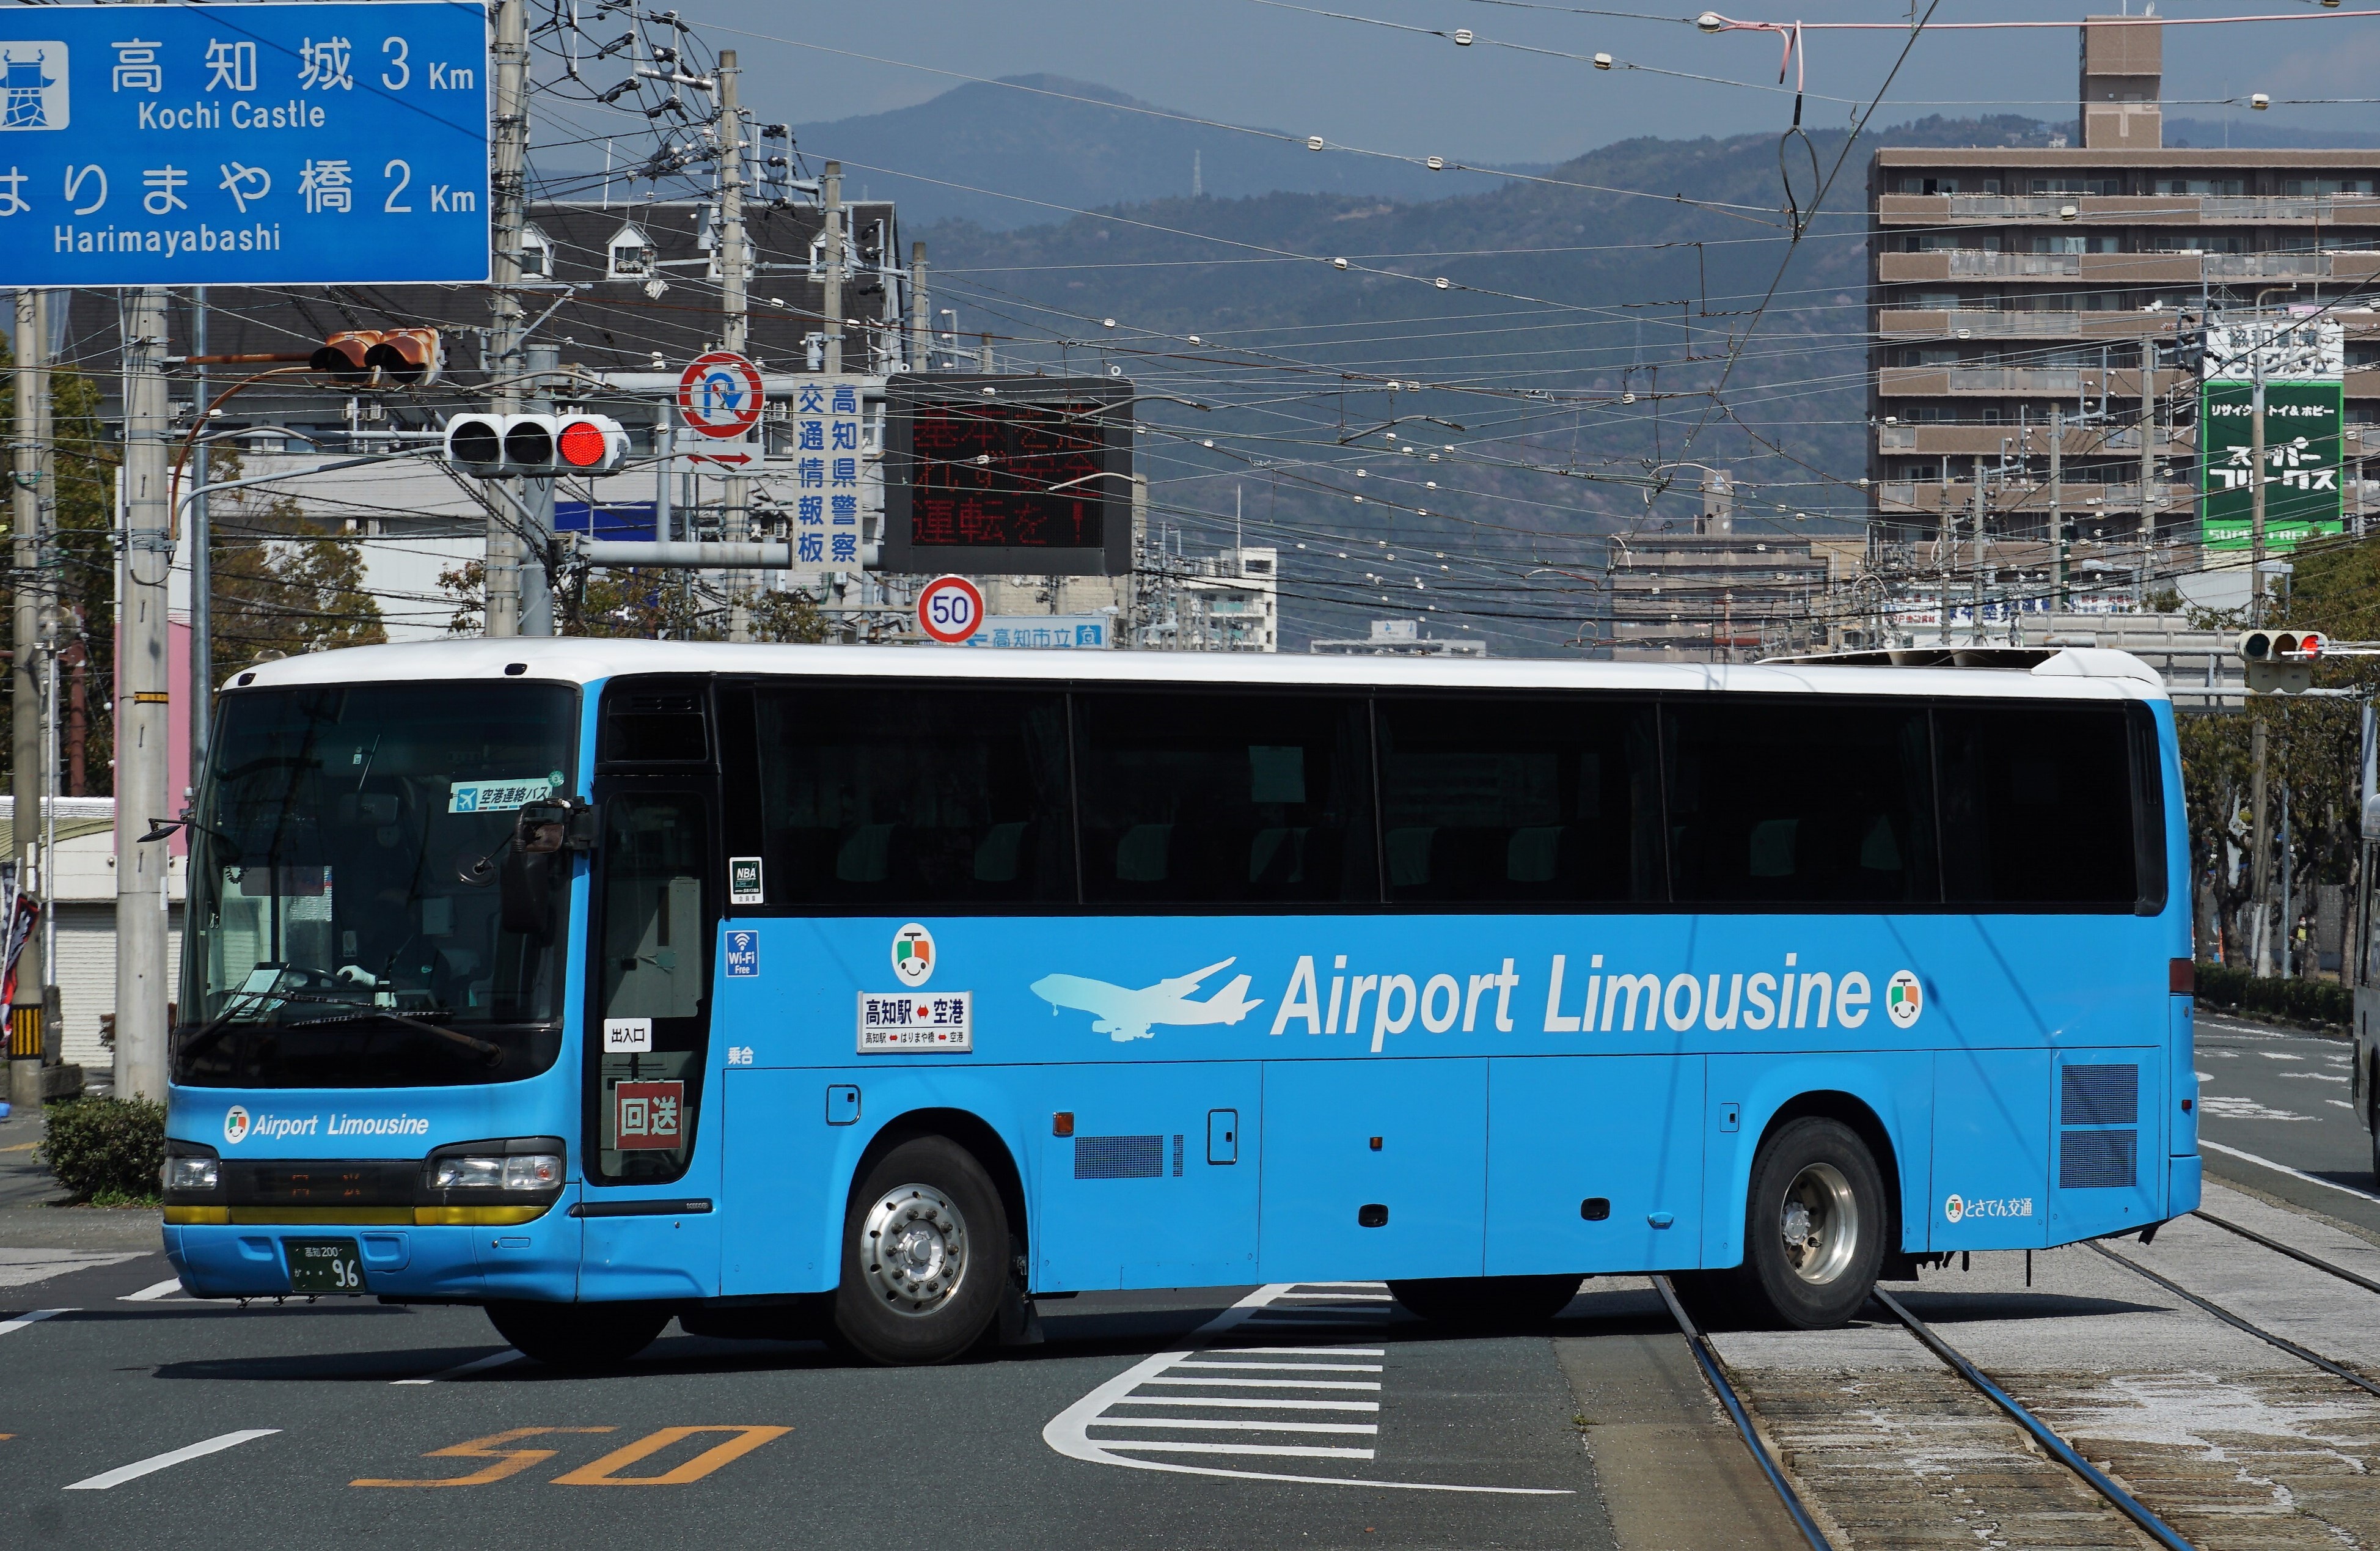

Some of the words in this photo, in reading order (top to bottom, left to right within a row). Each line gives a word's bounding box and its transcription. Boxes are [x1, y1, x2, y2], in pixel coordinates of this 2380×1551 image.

[111, 36, 354, 93] 高知城
[382, 36, 410, 90] 3
[429, 62, 474, 90] Km
[139, 100, 220, 129] Kochi
[231, 100, 326, 129] Castle
[384, 159, 412, 213] 2
[431, 185, 476, 212] Km
[54, 222, 280, 258] Harimayabashi
[798, 383, 824, 562] 交通情報板
[832, 383, 857, 562] 高知県警察
[2208, 529, 2254, 540] SUPE
[933, 596, 968, 624] 50
[993, 628, 1071, 648] 高知市立
[480, 787, 548, 804] 空港連絡バス
[736, 868, 756, 878] NBA
[729, 952, 755, 965] Wi-Fi
[734, 965, 750, 974] Free
[866, 999, 912, 1025] 高知駅
[934, 998, 964, 1024] 空港
[1270, 955, 1518, 1052] Airport
[1543, 952, 1870, 1033] Limousine
[611, 1027, 645, 1044] 出入口
[865, 1032, 887, 1044] 高知駅
[901, 1031, 935, 1043] はりまや橋
[950, 1031, 964, 1043] 空港
[728, 1046, 753, 1065] 乗合
[252, 1114, 318, 1139] Airport
[328, 1113, 429, 1135] Limousine
[620, 1095, 678, 1137] 回送
[1964, 1197, 2033, 1217] とさでん交通
[348, 1425, 794, 1487] 50
